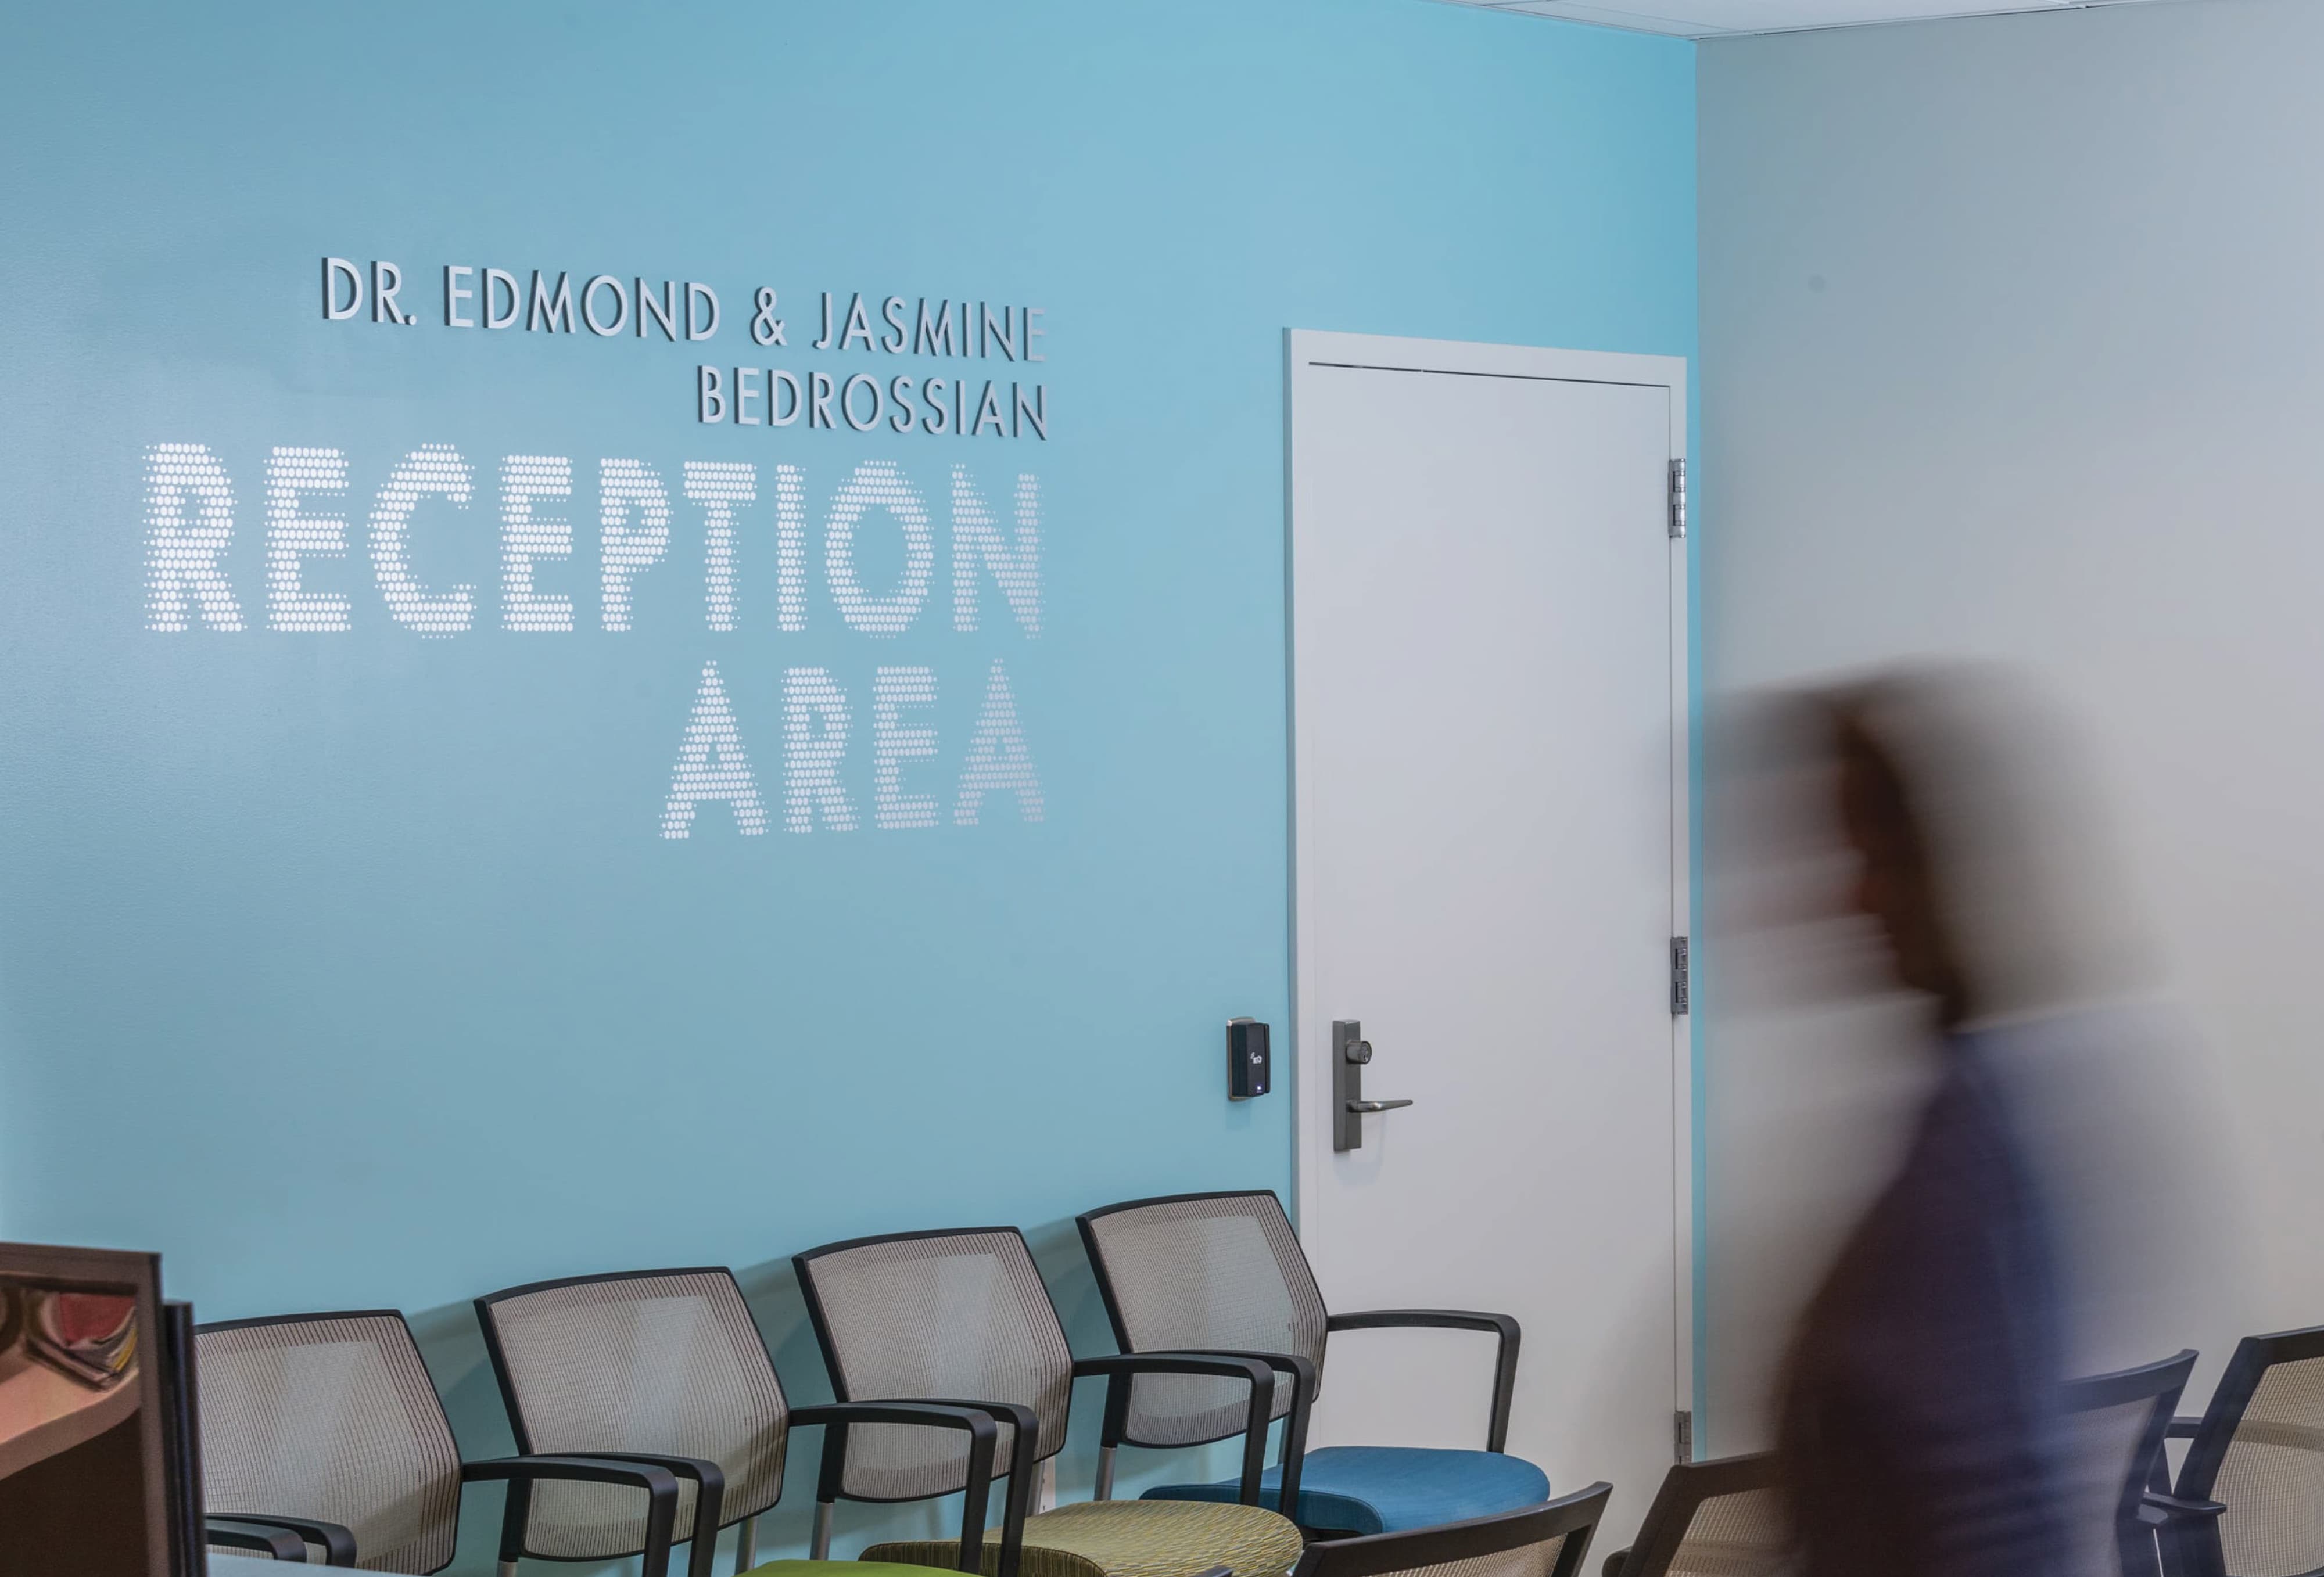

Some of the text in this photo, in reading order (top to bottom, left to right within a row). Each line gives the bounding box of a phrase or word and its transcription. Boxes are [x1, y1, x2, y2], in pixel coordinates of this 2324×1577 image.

[321, 257, 1048, 361] DR. EDMOND & JASMINE
[697, 365, 1048, 441] BEDROSSIAN
[143, 443, 1045, 639] RECEPTION
[659, 658, 1046, 840] AREA
